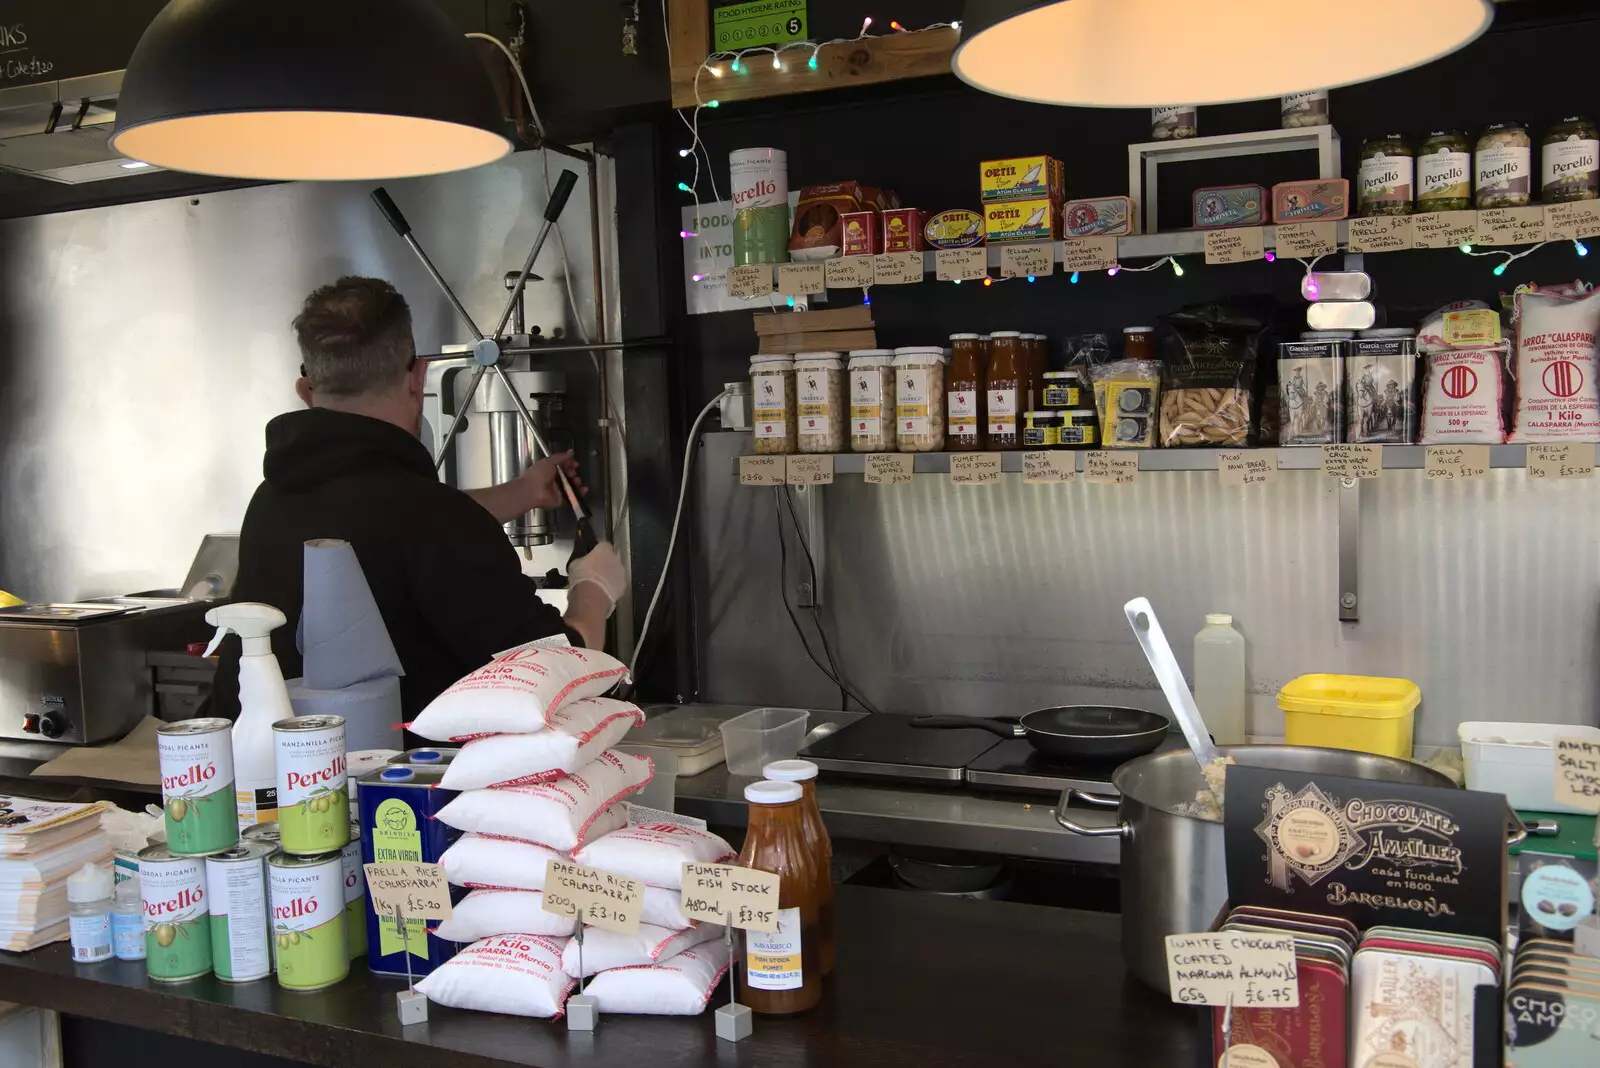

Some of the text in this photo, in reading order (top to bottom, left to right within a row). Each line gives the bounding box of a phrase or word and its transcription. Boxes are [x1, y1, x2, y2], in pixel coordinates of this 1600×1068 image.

[718, 0, 802, 18] FOOD HYGIENE RATING
[789, 19, 799, 34] 5
[1552, 155, 1593, 175] Perelló
[984, 166, 1017, 178] ORTIZ
[1424, 167, 1463, 186] Perelló
[1480, 162, 1518, 182] Perelló
[1364, 171, 1399, 190] Perelló
[1482, 209, 1505, 217] NEW!
[1548, 203, 1573, 213] NEW!
[942, 213, 970, 222] ORTIZ
[988, 209, 1021, 220] ORTIZ
[1416, 214, 1440, 224] NEW!
[1482, 216, 1516, 225] PERELLO
[1551, 211, 1592, 221] PERELLO
[693, 214, 729, 230] FOOD
[1354, 218, 1379, 228] NEW!
[1416, 223, 1450, 232] PERELLO
[1492, 223, 1519, 231] GARLIC
[1350, 228, 1387, 237] PERELLO
[1442, 225, 1475, 237] PEPPERS
[1522, 334, 1547, 348] ARROZ
[1547, 411, 1582, 420] 1 Kilo
[1324, 445, 1351, 453] GARCIA
[1427, 448, 1464, 456] PAELLA
[1529, 445, 1569, 454] PAELLA
[953, 454, 982, 462] FUMET
[1024, 451, 1047, 460] NEW!
[1437, 456, 1461, 465] RICE
[1539, 453, 1567, 461] RICE
[975, 461, 996, 469] STOCK
[1245, 459, 1266, 469] BREAD
[1427, 465, 1484, 480] 500g £3.10
[1559, 464, 1591, 477] £5.20
[482, 667, 513, 675] Kilo
[499, 673, 538, 688] (Murcia)
[177, 743, 208, 751] PICANTE
[282, 739, 327, 748] MANZANILLA
[1558, 753, 1596, 772] SALT
[377, 848, 419, 862] EXTRA VIRGIN
[1345, 829, 1462, 876] AMATLLER
[165, 866, 197, 877] PICANTE
[367, 866, 439, 878] PAELLA RICE
[553, 862, 636, 892] PAELLA RICE
[687, 864, 734, 878] FUMET
[1372, 867, 1459, 886] casa fundada
[288, 875, 320, 883] PICANTE
[373, 878, 442, 890] "CALASPARRA"
[1386, 880, 1402, 889] en
[557, 876, 637, 903] "CALASPARRA"
[697, 879, 771, 895] FISH STOCK
[142, 884, 204, 917] Perelló
[406, 893, 441, 912] £5.20
[1327, 881, 1456, 917] BARCELONA
[547, 893, 627, 922] 500g £3.10
[685, 897, 773, 924] 480ml £3.95
[485, 939, 531, 951] 1 Kilo
[754, 941, 792, 950] NAVARRICO
[1171, 937, 1294, 952] WHITE CHOCOLATE
[514, 951, 554, 973] (Murcia)
[1173, 953, 1232, 966] COATED
[1176, 968, 1234, 981] MARCONA
[1178, 981, 1293, 1004] 65g £6.75
